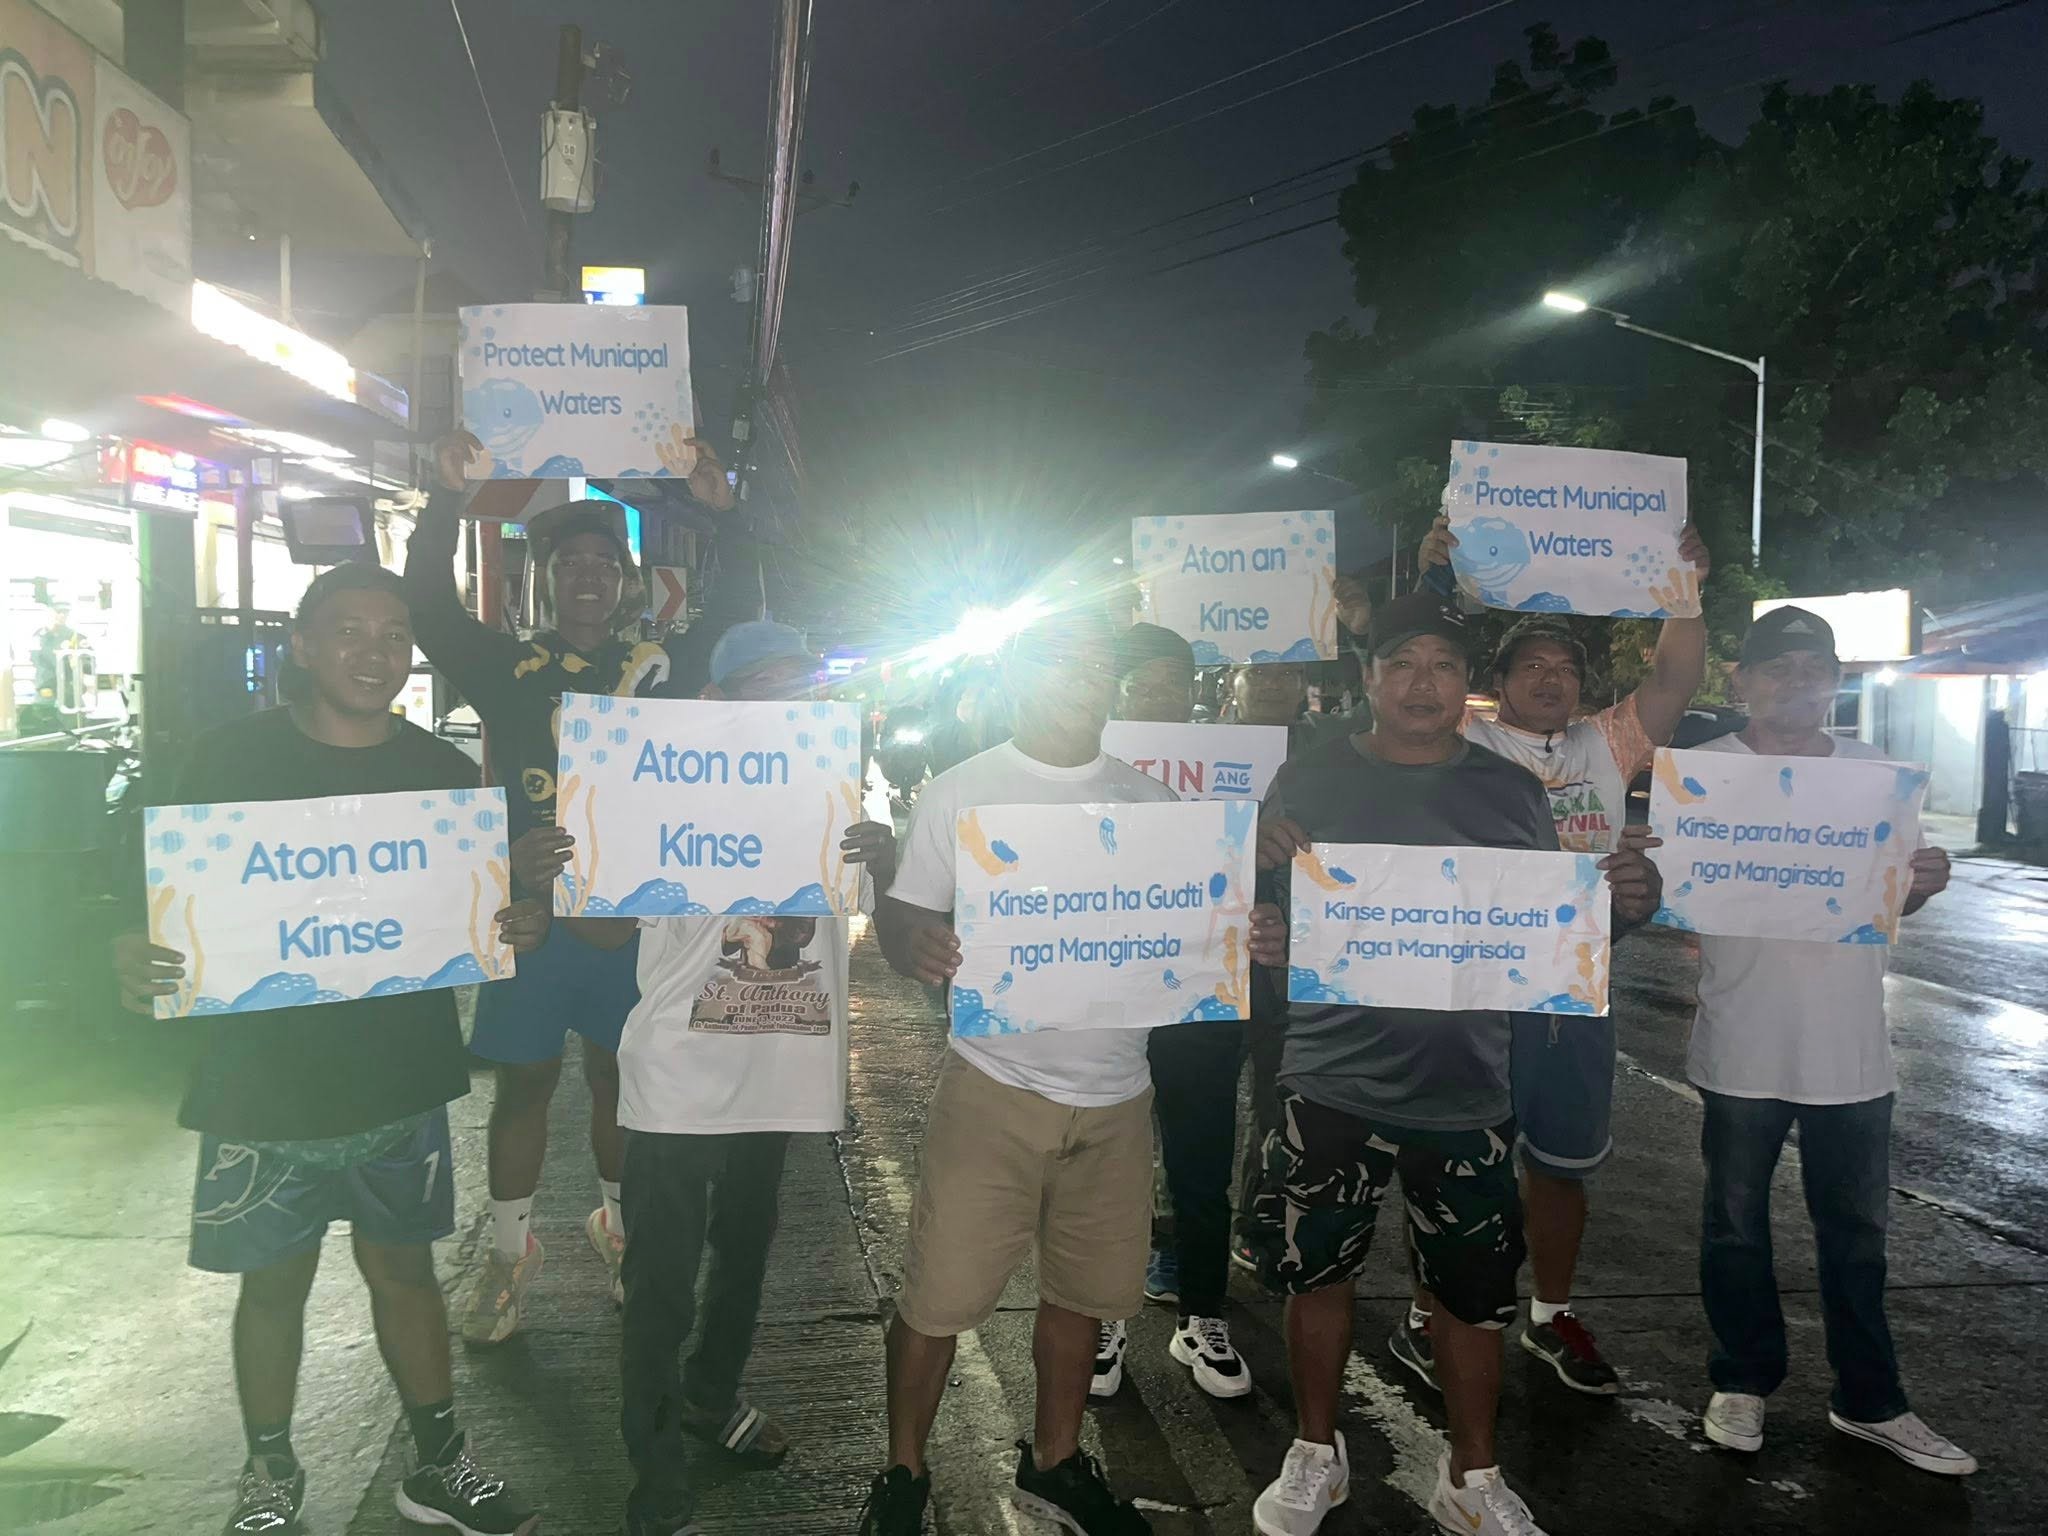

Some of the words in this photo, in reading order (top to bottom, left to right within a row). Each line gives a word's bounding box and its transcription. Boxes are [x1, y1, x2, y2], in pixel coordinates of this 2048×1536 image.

[484, 342, 565, 367] Protect
[570, 342, 669, 374] Municipal
[540, 390, 622, 415] Waters
[1475, 481, 1557, 509] Protect
[1563, 485, 1667, 516] Municipal
[1181, 543, 1246, 574] Aton
[1252, 546, 1287, 573] an
[1529, 530, 1613, 558] Waters
[1199, 600, 1270, 632] Kinse
[632, 738, 729, 785] Aton
[738, 750, 788, 786] an
[1214, 770, 1250, 786] ANG
[660, 822, 763, 868] Kinse
[1676, 816, 1729, 839] Kinse
[1732, 823, 1782, 845] para
[1784, 822, 1810, 844] ha
[1815, 825, 1869, 848] Gudti
[241, 840, 357, 884] Aton
[368, 838, 428, 874] an
[1691, 860, 1731, 884] nga
[1735, 860, 1845, 889] Mangirisda
[989, 889, 1048, 917] Kinse
[1053, 889, 1107, 920] para
[1112, 884, 1141, 911] ha
[1146, 882, 1203, 910] Gudti
[1325, 901, 1386, 921] Kinse
[1391, 906, 1448, 926] para
[1452, 905, 1481, 925] ha
[1487, 907, 1549, 928] Gudti
[279, 916, 404, 960] Kinse
[1010, 942, 1054, 971] nga
[1059, 932, 1182, 967] Mangirisda
[1346, 939, 1392, 960] nga
[1398, 938, 1526, 964] Mangirisda
[700, 982, 731, 1000] St.
[739, 982, 830, 1009] Anthony
[726, 1003, 746, 1014] of
[750, 1003, 806, 1014] Padua
